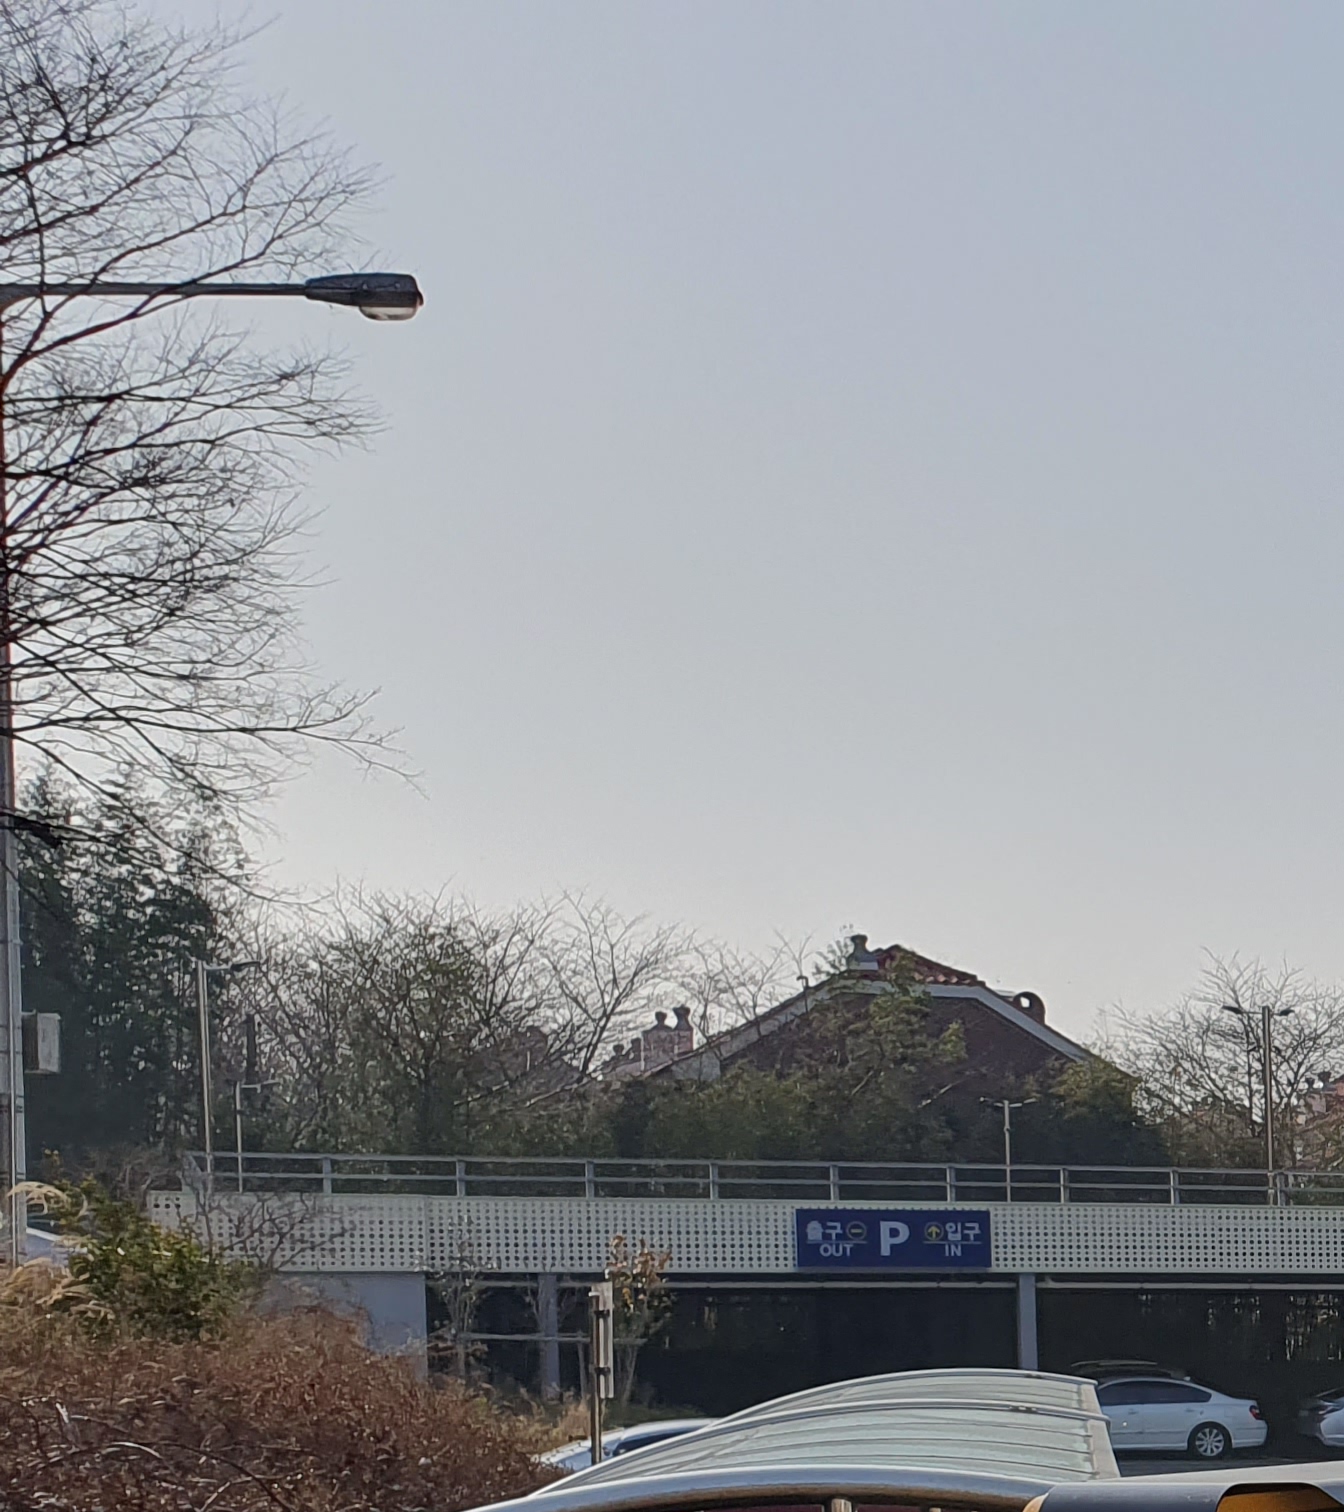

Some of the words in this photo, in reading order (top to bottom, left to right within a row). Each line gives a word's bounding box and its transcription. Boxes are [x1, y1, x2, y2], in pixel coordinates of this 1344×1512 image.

[880, 1221, 910, 1257] P
[946, 1222, 981, 1242] 입구
[820, 1244, 853, 1257] OUT
[945, 1244, 962, 1257] IN
